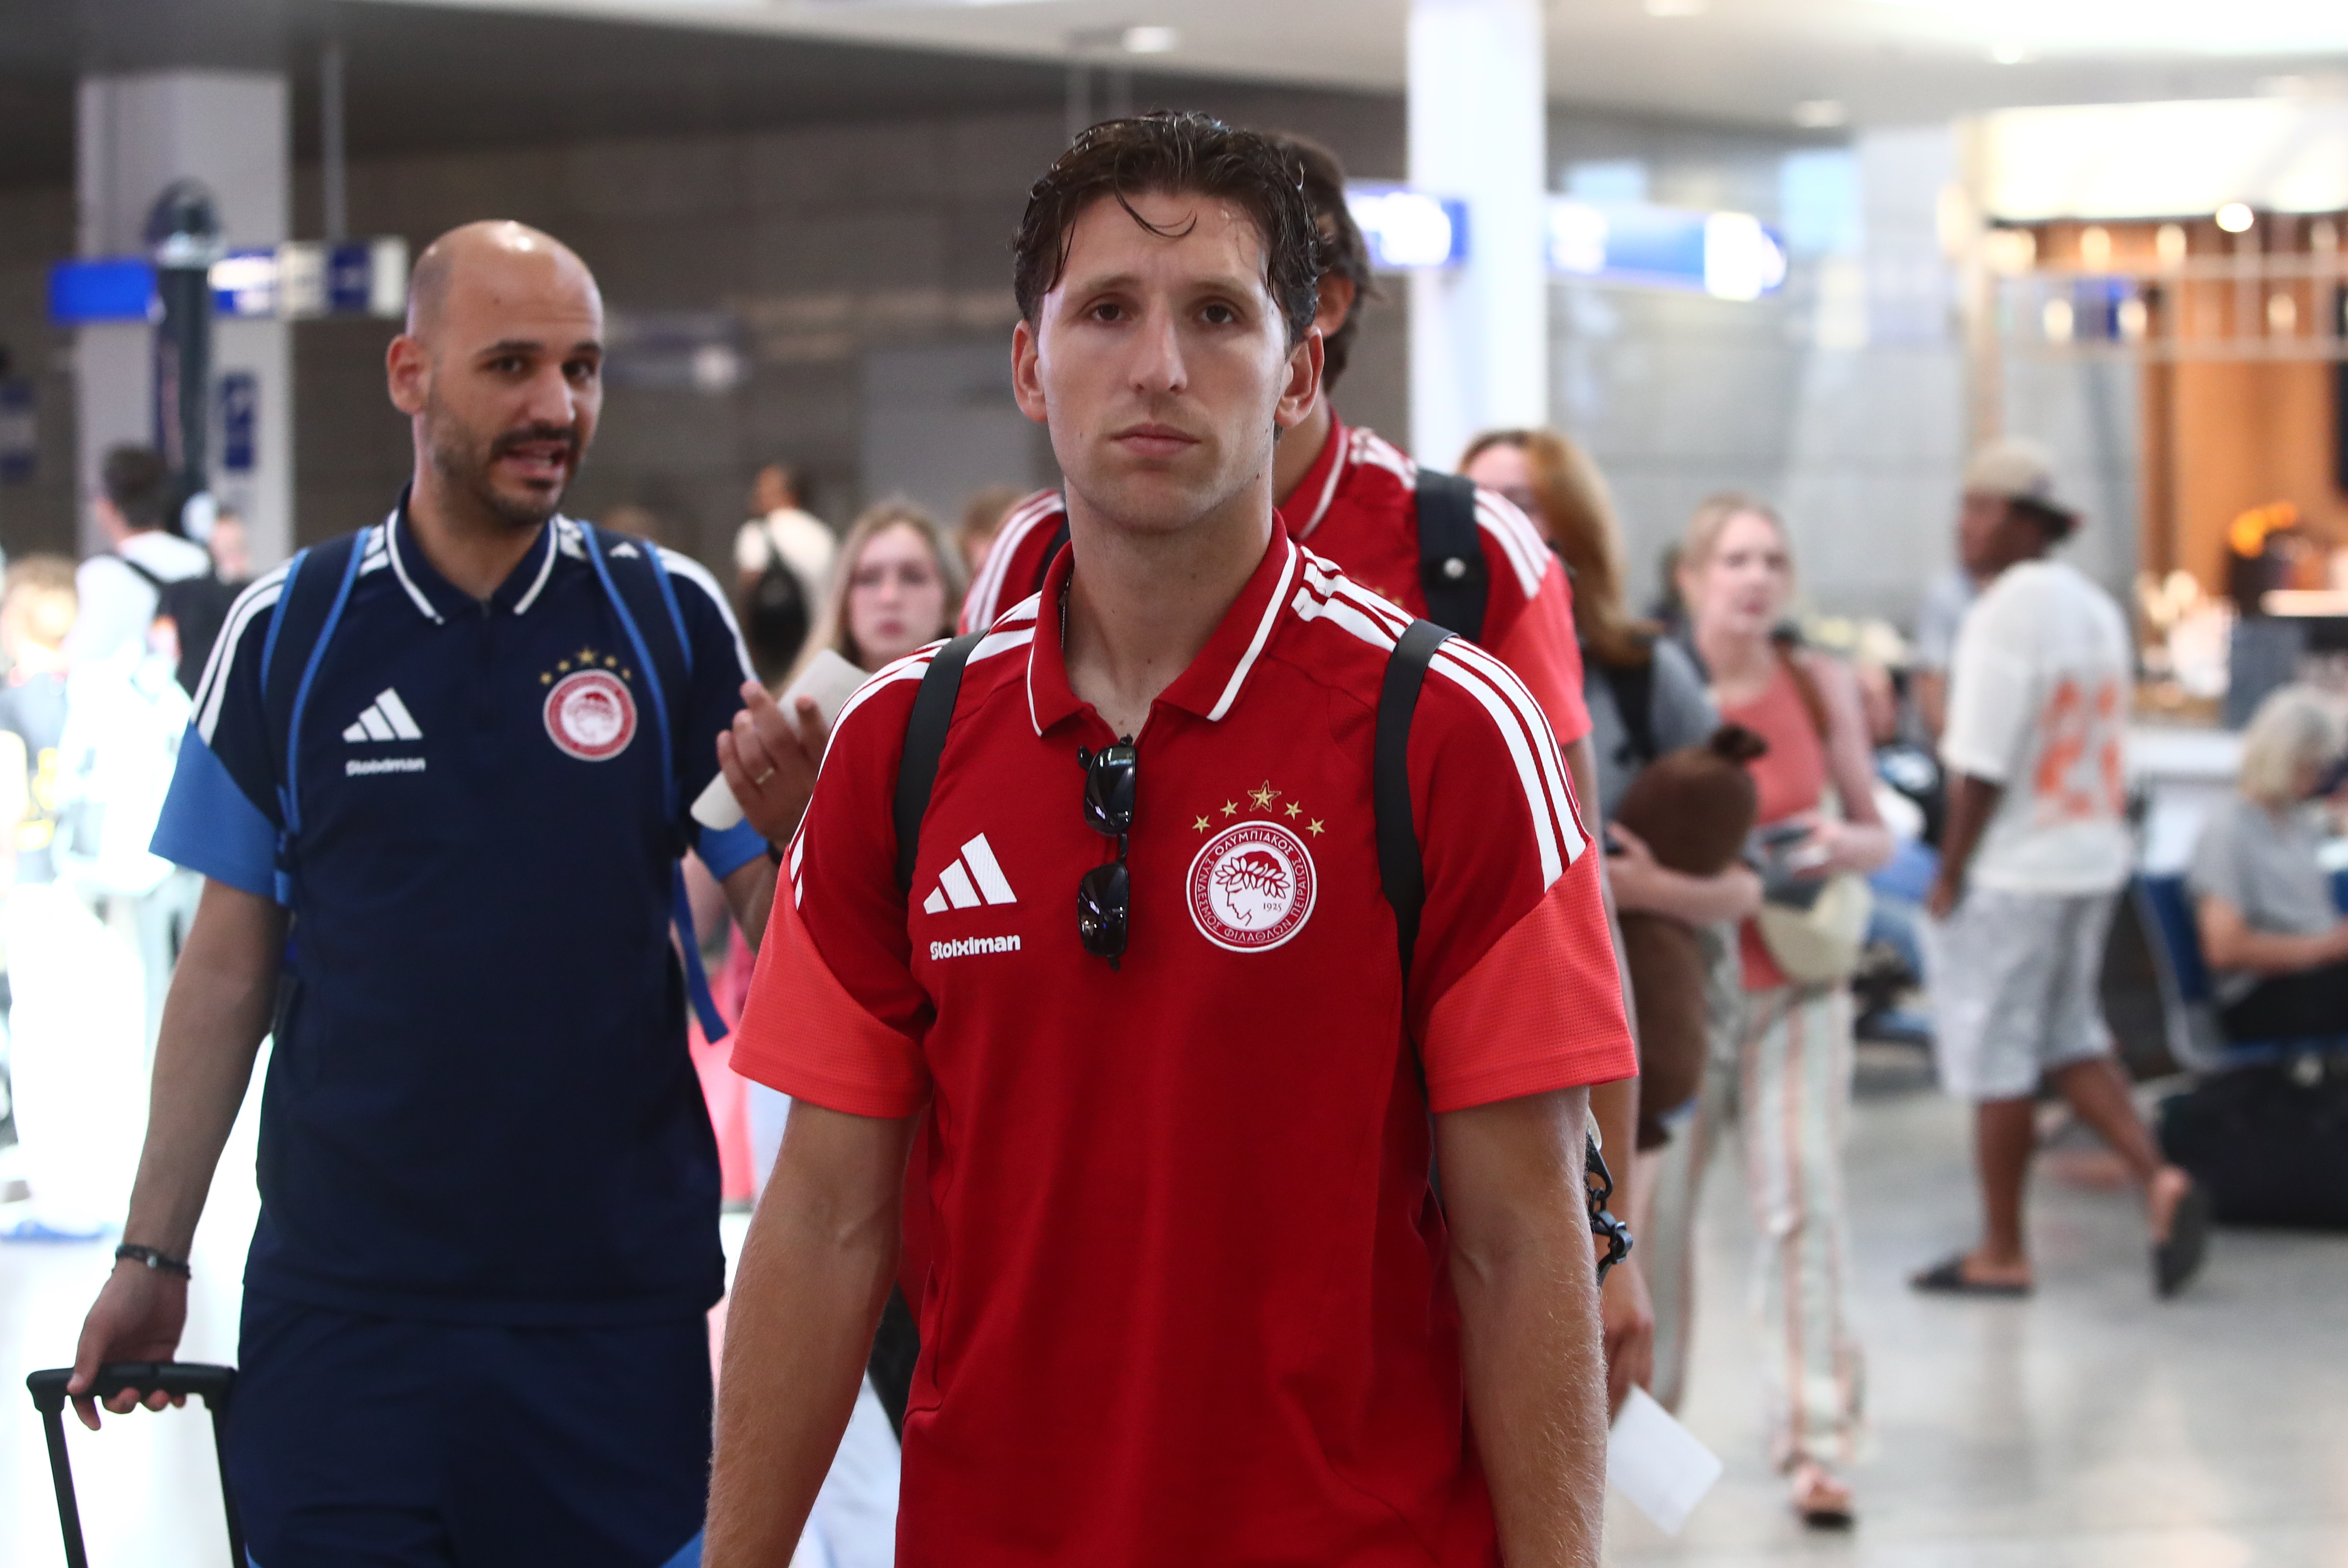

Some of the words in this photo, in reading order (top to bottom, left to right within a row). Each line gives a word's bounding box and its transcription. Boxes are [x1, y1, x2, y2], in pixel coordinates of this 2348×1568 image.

[1215, 831, 1293, 855] ΟΛΥΜΠΙΑΚΟΣ
[1198, 857, 1222, 931] ΣΥΝΔΕΣΜΟΣ
[1224, 918, 1291, 942] ΦΙΛΑΘΛΩΝ
[1291, 856, 1307, 918] ΠΕΙΡΑΙΩΣ
[1263, 902, 1282, 912] 1925
[930, 935, 1021, 961] Stoiximan
